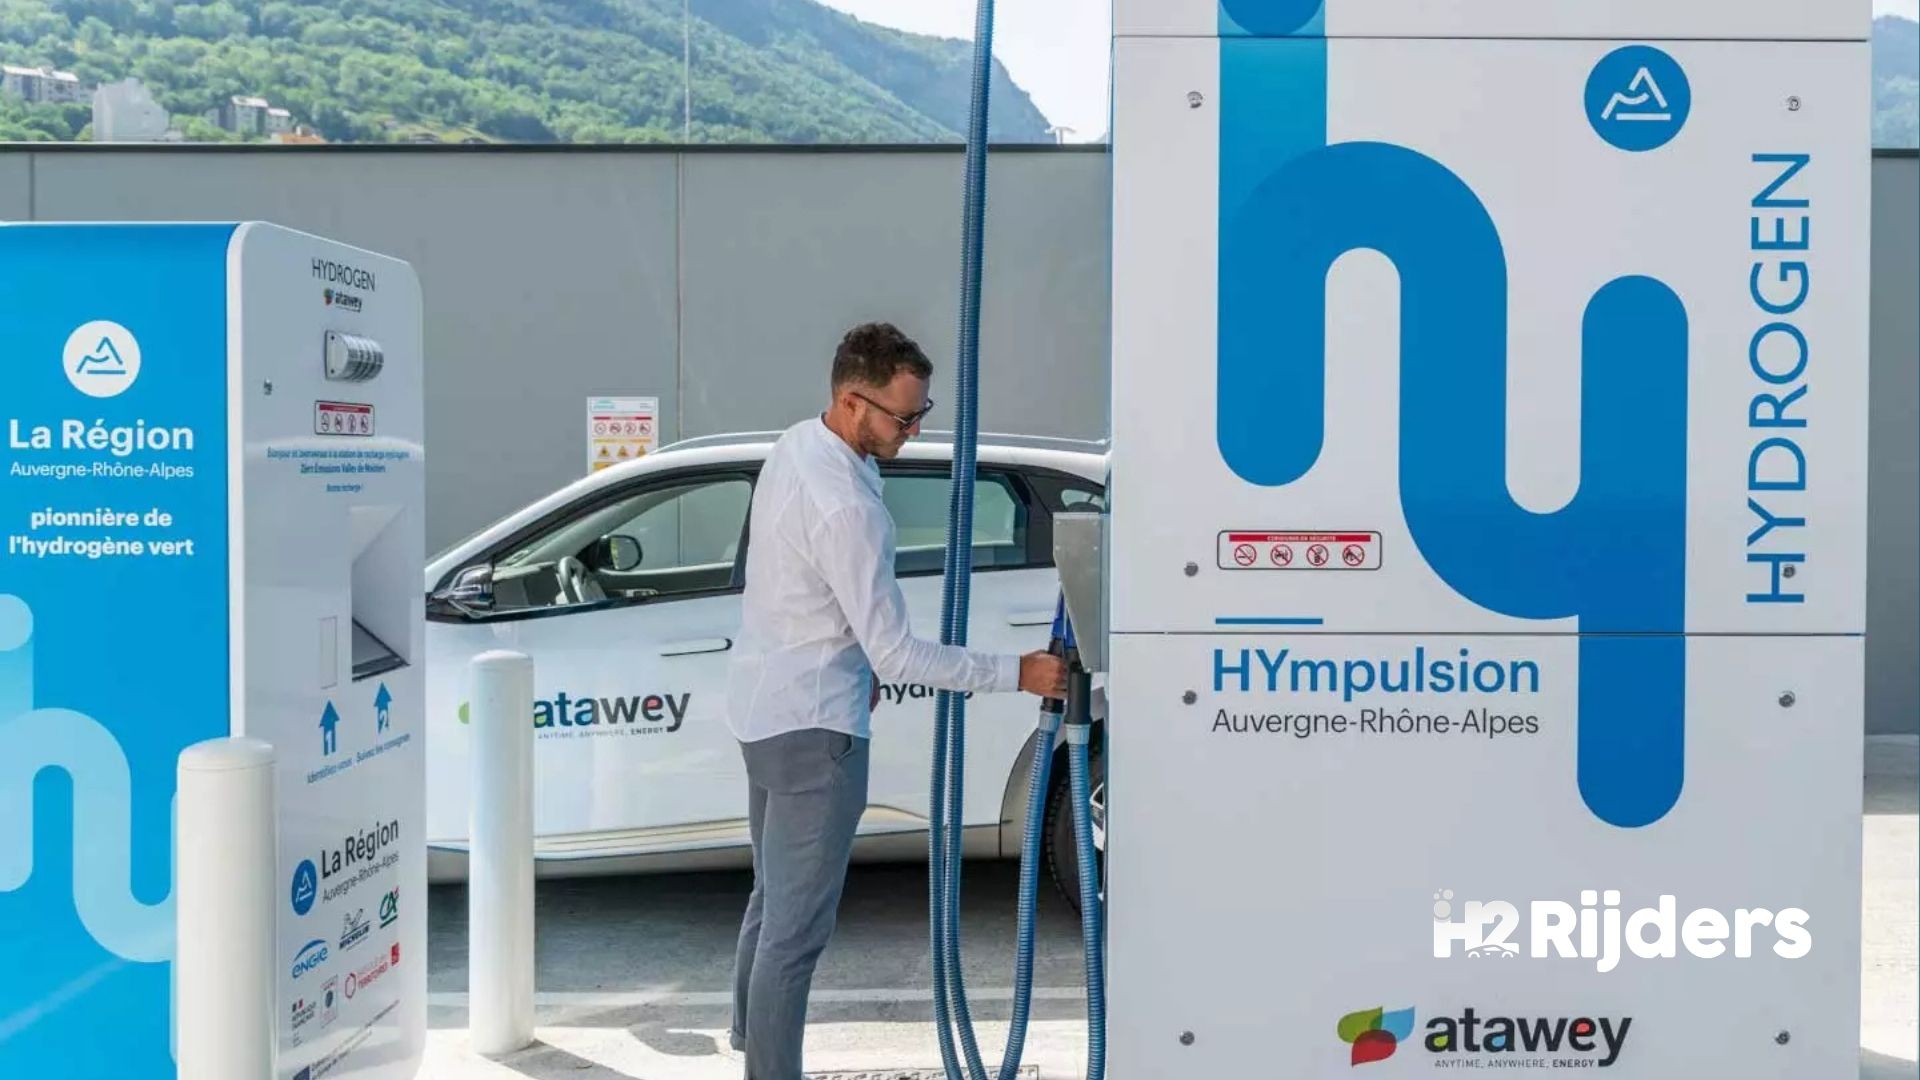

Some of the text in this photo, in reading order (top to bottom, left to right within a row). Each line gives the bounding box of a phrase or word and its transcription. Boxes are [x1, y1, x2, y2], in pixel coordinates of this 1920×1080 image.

[311, 258, 376, 292] HYDROGEN
[1746, 154, 1810, 603] HYDROGEN
[9, 418, 195, 456] La Région
[10, 462, 194, 481] Auvergne-Rhône-Alpes
[31, 507, 173, 531] pionnière de
[9, 535, 195, 559] l'hydrogène vert
[1213, 646, 1539, 702] HYmpulsion
[534, 692, 691, 732] atawey
[1212, 707, 1539, 739] Auvergne-Rhône-Alpes
[321, 819, 399, 879] La Région
[1424, 1007, 1632, 1067] atawey
[1434, 1058, 1594, 1069] ANYTIME, ANYWHERE, ENERGY
